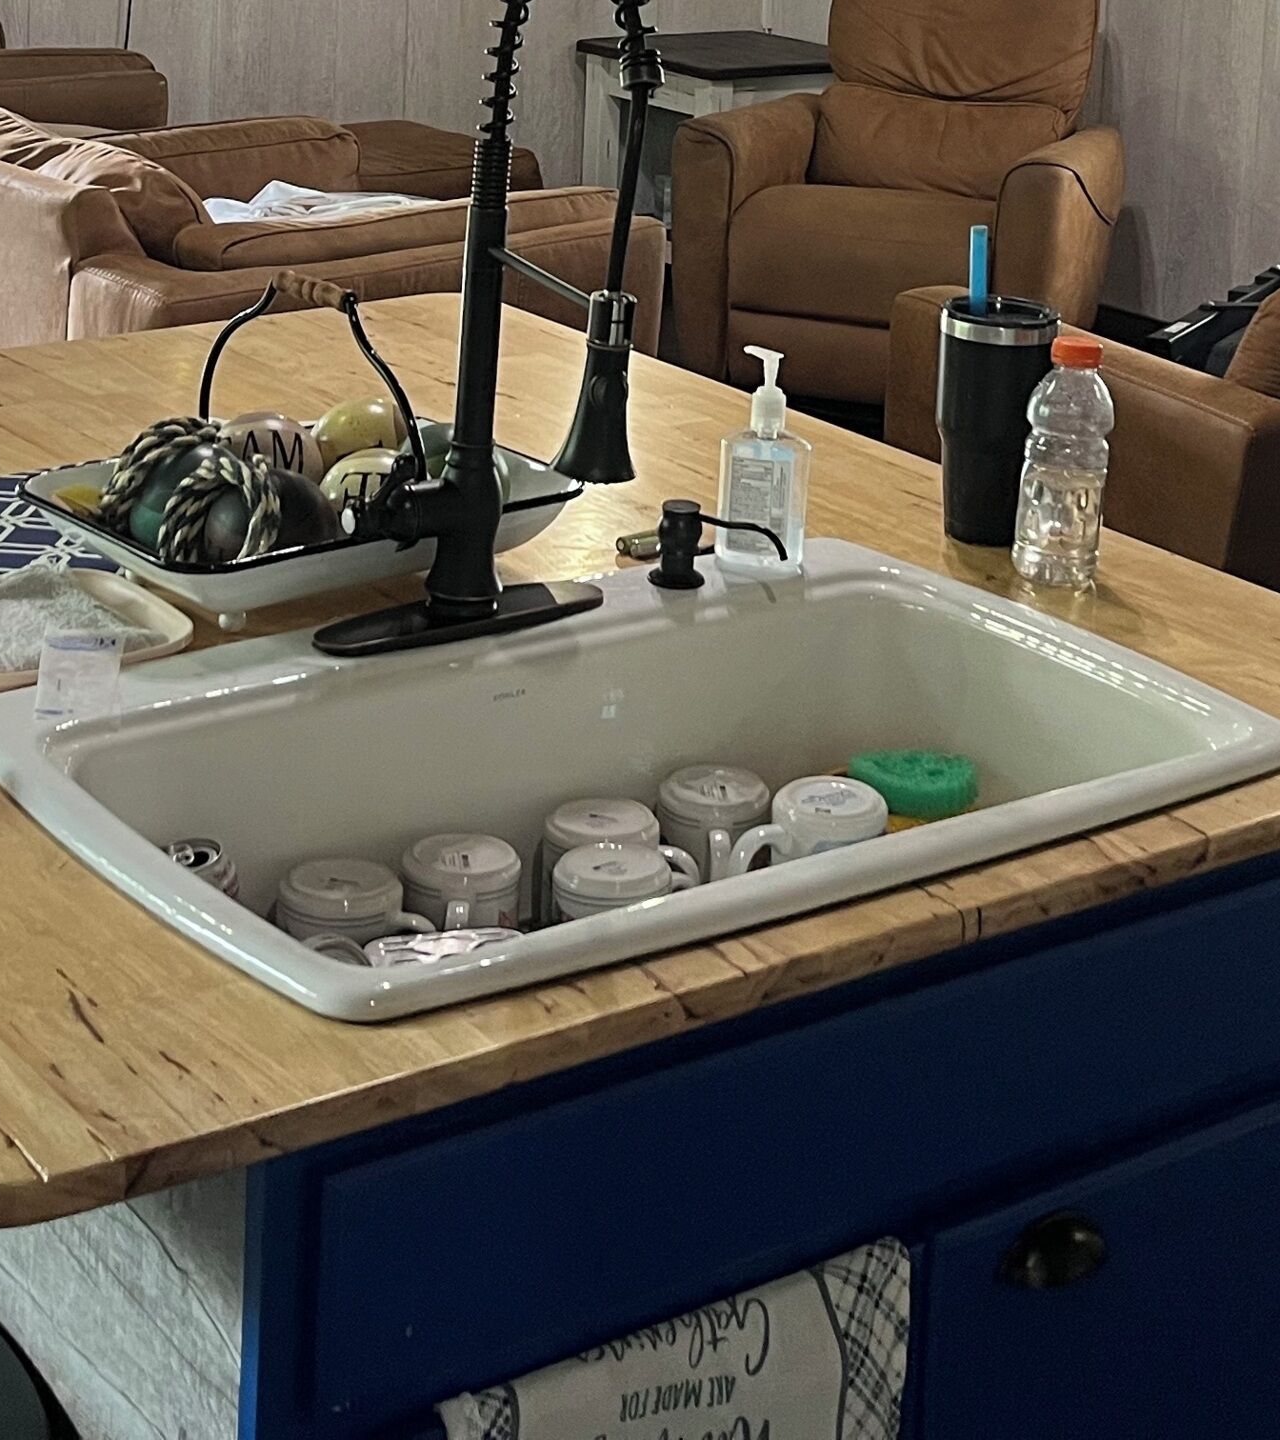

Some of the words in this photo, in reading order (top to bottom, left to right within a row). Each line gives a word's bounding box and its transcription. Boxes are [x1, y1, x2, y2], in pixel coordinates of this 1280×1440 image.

[620, 1388, 649, 1423] FOR
[651, 1378, 703, 1416] MADE
[707, 1375, 736, 1408] ARE
